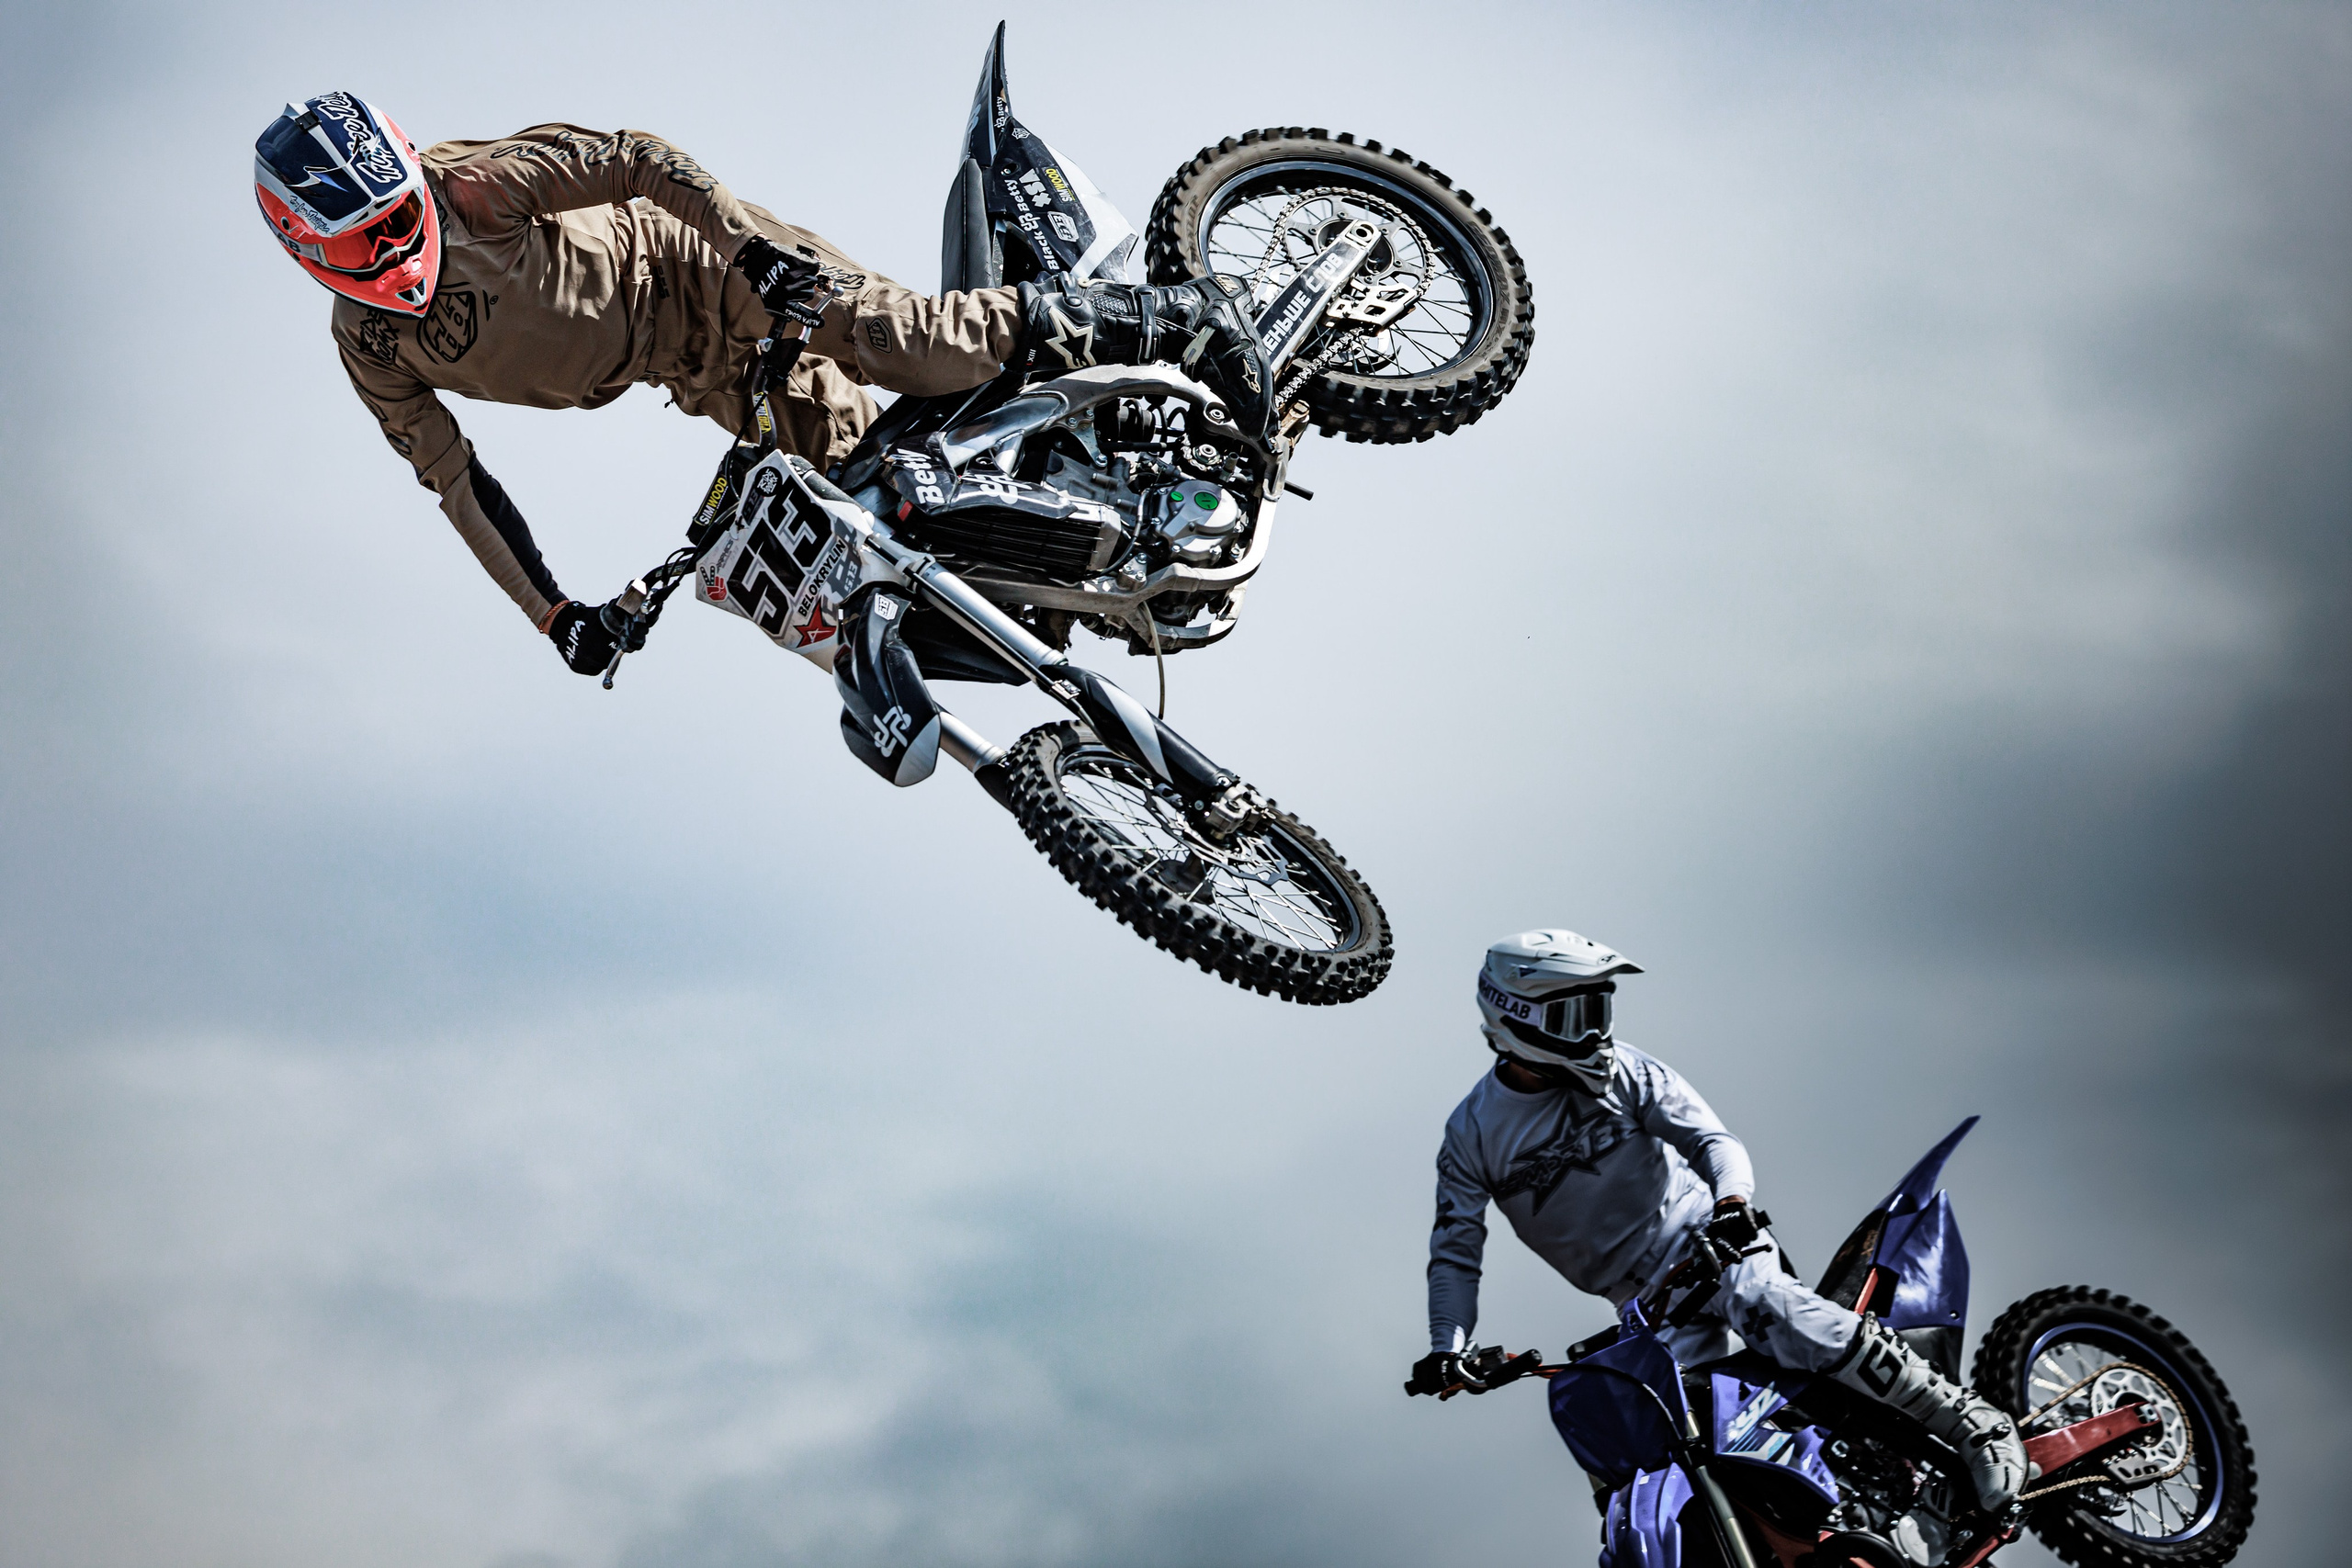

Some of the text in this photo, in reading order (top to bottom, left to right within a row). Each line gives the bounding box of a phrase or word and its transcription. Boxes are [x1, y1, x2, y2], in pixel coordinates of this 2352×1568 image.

[1045, 168, 1073, 202] SIMWOOD
[1004, 179, 1060, 270] Black Betty
[758, 260, 790, 299] ALIPA
[1261, 289, 1312, 356] ЕНЬШЕ
[698, 477, 729, 525] SIMWOOD
[725, 475, 833, 636] 573
[797, 539, 847, 618] BELOKRYLIN
[565, 619, 586, 664] ALIPA
